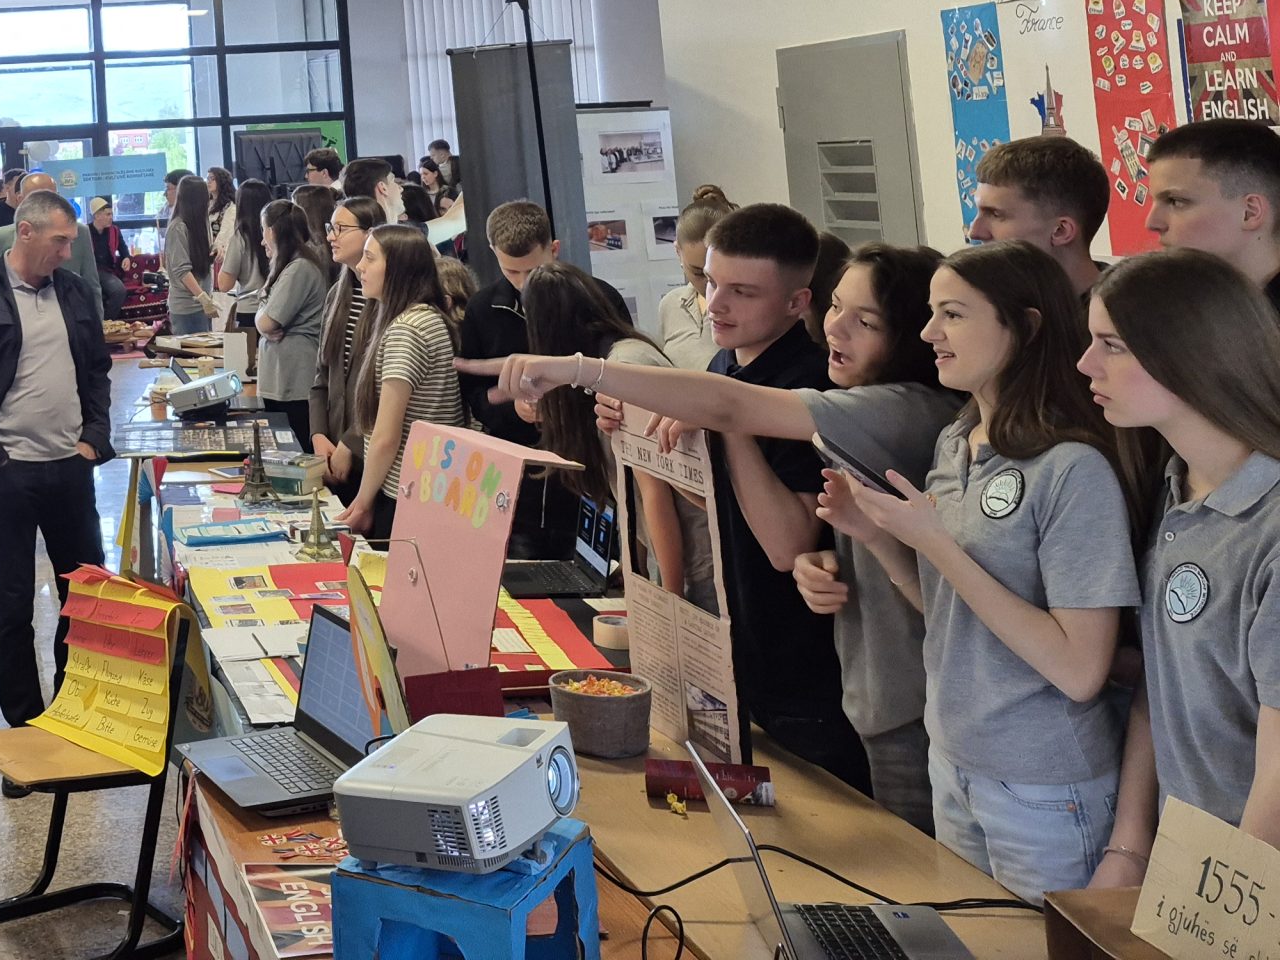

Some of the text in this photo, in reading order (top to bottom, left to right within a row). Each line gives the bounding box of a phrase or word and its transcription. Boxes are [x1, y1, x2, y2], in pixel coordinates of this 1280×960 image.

[1015, 3, 1064, 35] France
[1203, 22, 1250, 48] CALM
[1220, 51, 1237, 63] AND
[1204, 67, 1258, 92] LEARN
[1201, 98, 1270, 121] ENGLISH
[412, 435, 503, 497] VISION
[636, 446, 652, 463] NEW
[656, 453, 675, 473] YORK
[678, 463, 704, 485] TIMES
[419, 470, 489, 529] BOARD
[141, 698, 154, 720] Zug
[96, 716, 115, 734] Bitte
[133, 726, 159, 748] Gemüse
[1195, 856, 1266, 926] 1555
[280, 882, 333, 945] ENGLISH
[1157, 895, 1166, 918] i
[1167, 904, 1215, 946] gjuhës
[1222, 937, 1238, 959] së
